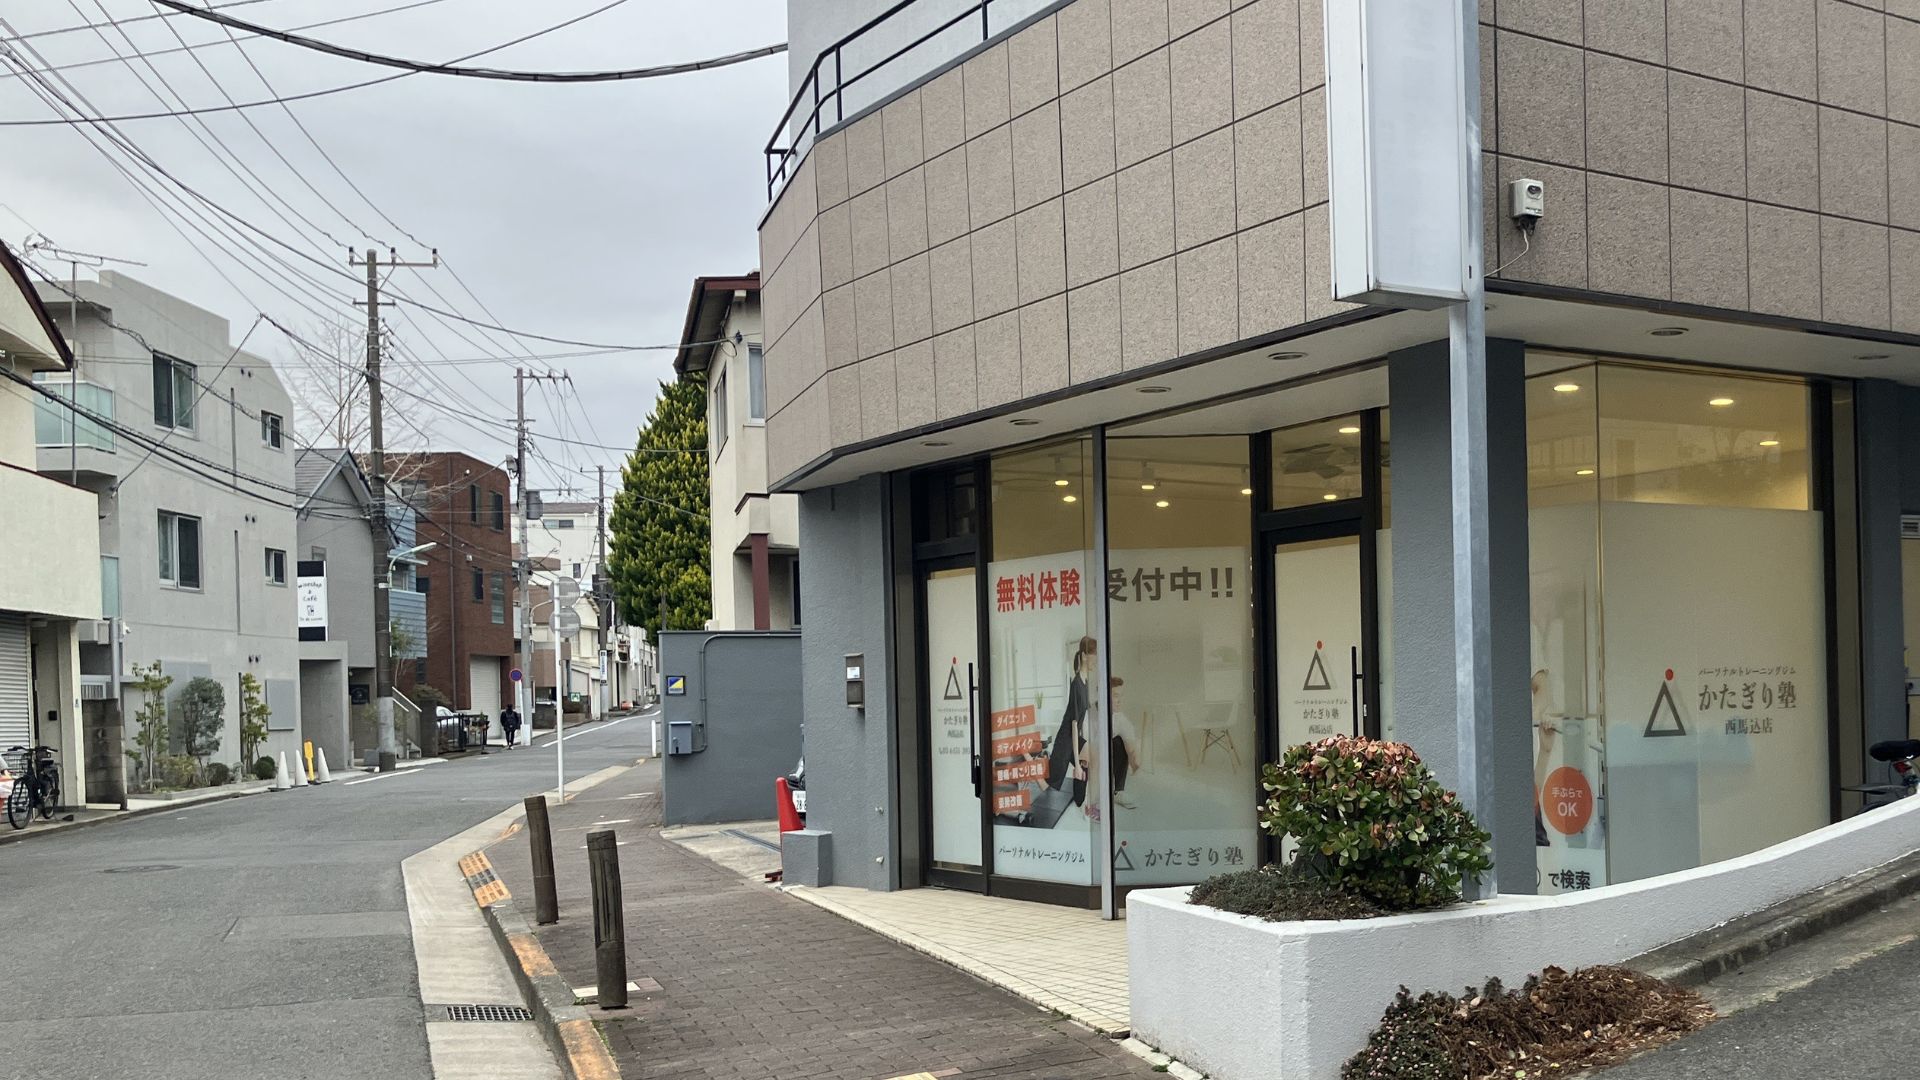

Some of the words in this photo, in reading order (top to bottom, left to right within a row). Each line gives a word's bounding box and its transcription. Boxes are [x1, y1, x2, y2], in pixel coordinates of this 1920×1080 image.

[996, 568, 1080, 612] 無料体験
[1698, 666, 1797, 677] パーソナルトレーニングジム
[1698, 681, 1797, 711] かたぎり塾
[997, 711, 1027, 727] ダイエット
[1725, 717, 1773, 735] 西馬込店
[997, 738, 1033, 754] ボディメイク
[1551, 787, 1583, 798] 手ぶらで
[1558, 802, 1578, 817] OK
[999, 845, 1085, 863] パーソナルトレーニングジム
[1144, 846, 1244, 867] かたぎり塾
[1548, 869, 1591, 891] で検索
